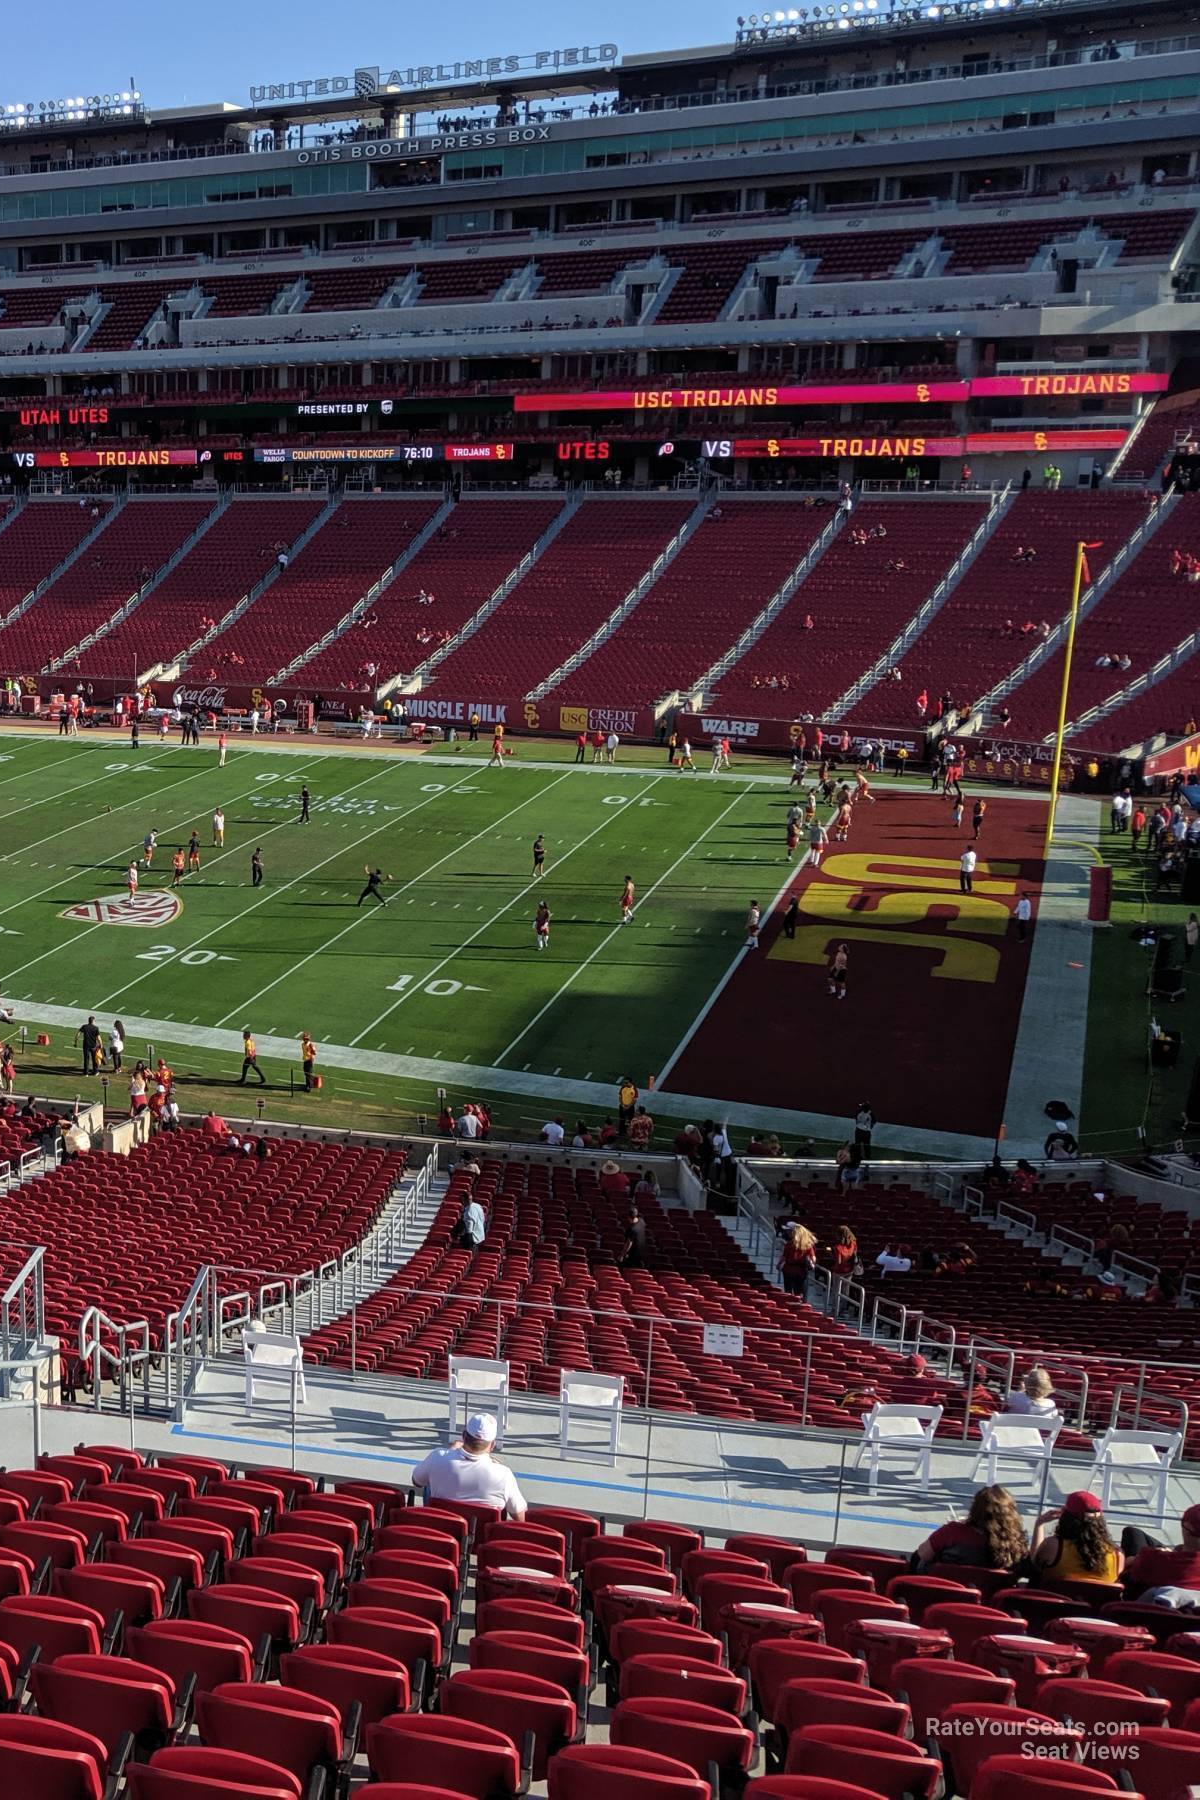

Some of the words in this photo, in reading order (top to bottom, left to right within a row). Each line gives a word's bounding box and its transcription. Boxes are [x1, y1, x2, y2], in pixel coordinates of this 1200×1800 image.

[250, 76, 348, 101] UNITED
[387, 55, 519, 86] AIRLINES
[536, 43, 618, 69] FIELD
[298, 147, 345, 163] OTIS
[351, 140, 420, 158] BOOTH
[431, 132, 497, 149] PRESS
[508, 127, 551, 142] BOX
[1021, 374, 1131, 395] TROJANS
[634, 391, 673, 409] USC
[680, 388, 778, 407] TROJANS
[21, 409, 60, 426] UTAH
[68, 408, 108, 425] UTES
[298, 404, 352, 415] PRESENTED
[356, 404, 368, 413] BY
[292, 450, 344, 461] COUNTDOWN
[346, 449, 358, 459] TO
[359, 449, 394, 459] KICKOFF
[404, 447, 433, 459] 76:10
[452, 447, 490, 457] TROJANS
[558, 442, 610, 460] UTES
[705, 440, 731, 456] VS
[819, 438, 926, 456] TROJANS
[16, 453, 35, 467] VS
[96, 450, 169, 466] TROJANS
[223, 452, 243, 461] UTES
[405, 699, 464, 720] MUSCLE
[468, 704, 506, 723] MILK
[560, 711, 587, 725] USC
[588, 708, 639, 721] CREDIT
[588, 718, 635, 733] UNION
[701, 718, 760, 737] WARE
[992, 741, 1021, 757] Keck
[254, 772, 307, 783] 30
[420, 782, 475, 795] 20
[767, 852, 1021, 984] USC
[135, 945, 219, 965] 20
[384, 973, 465, 997] 10
